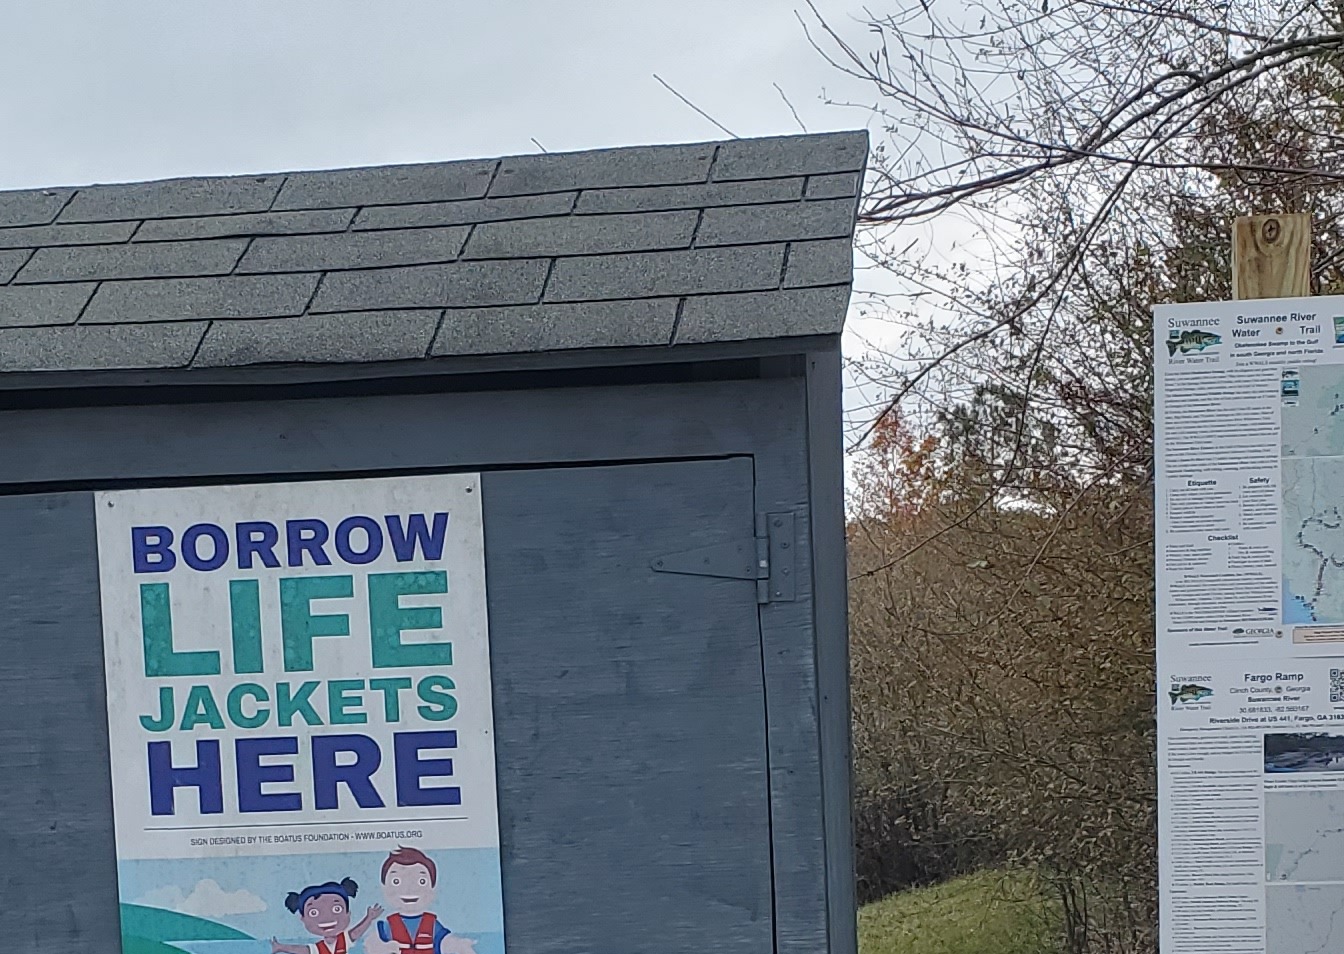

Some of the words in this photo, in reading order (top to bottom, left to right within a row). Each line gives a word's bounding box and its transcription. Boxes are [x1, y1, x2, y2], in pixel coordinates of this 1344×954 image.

[1168, 317, 1220, 328] Suwannee
[1237, 315, 1287, 325] Suwannee
[1290, 312, 1317, 321] River
[1232, 328, 1261, 338] Water
[1299, 325, 1321, 334] Trail
[131, 512, 449, 574] BORROW
[140, 570, 453, 677] LIFE
[1245, 627, 1274, 635] GEORGIA
[1244, 673, 1273, 684] Fargo
[1275, 673, 1304, 682] Ramp
[139, 675, 458, 732] JACKETS
[1209, 716, 1240, 724] Riverside
[147, 730, 462, 816] HERE
[190, 838, 208, 846] SIGN
[210, 836, 246, 845] DESIGNED
[247, 836, 257, 844] BY
[258, 835, 272, 844] THE
[274, 834, 303, 843] BOATUS
[303, 832, 350, 842] FOUNDATION
[355, 830, 423, 840] WWW.BOATUS.ORG
